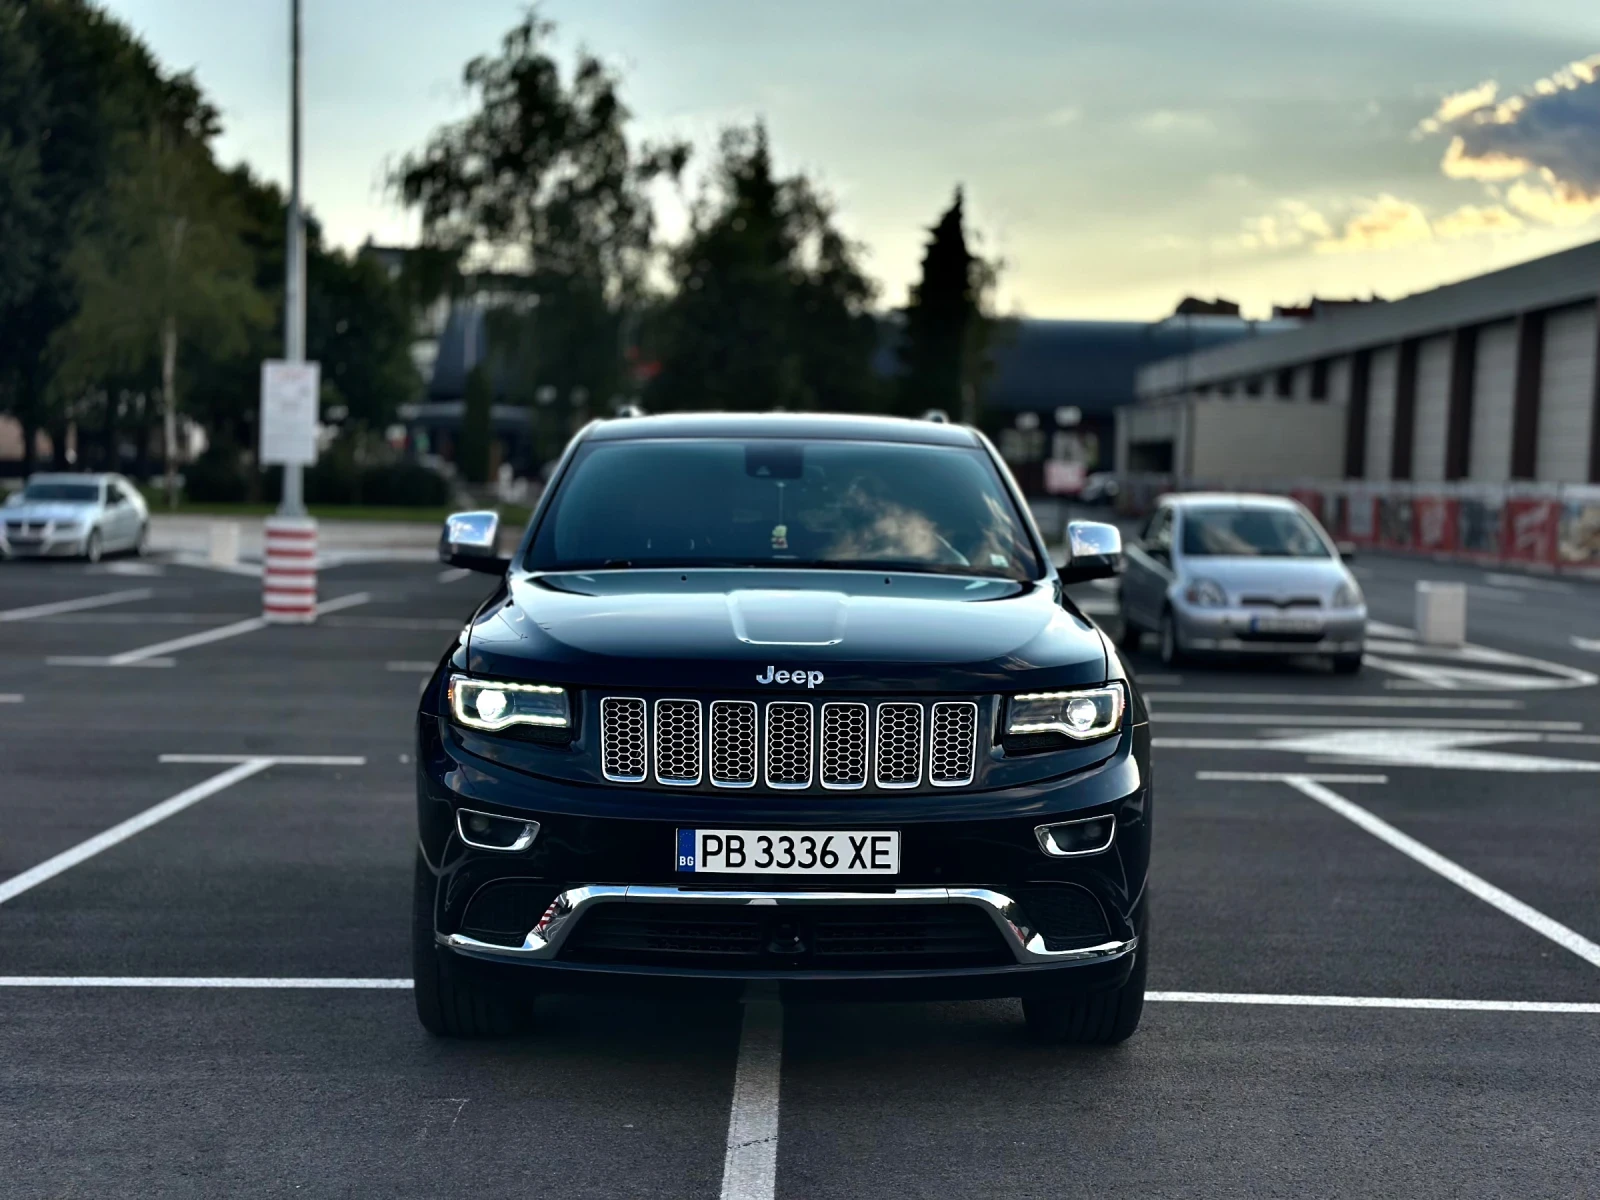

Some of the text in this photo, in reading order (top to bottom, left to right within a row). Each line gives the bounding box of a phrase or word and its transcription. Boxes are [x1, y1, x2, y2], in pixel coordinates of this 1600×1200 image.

[756, 666, 824, 688] Jeep
[679, 856, 694, 866] BG
[702, 834, 891, 869] PB 3336 XE
